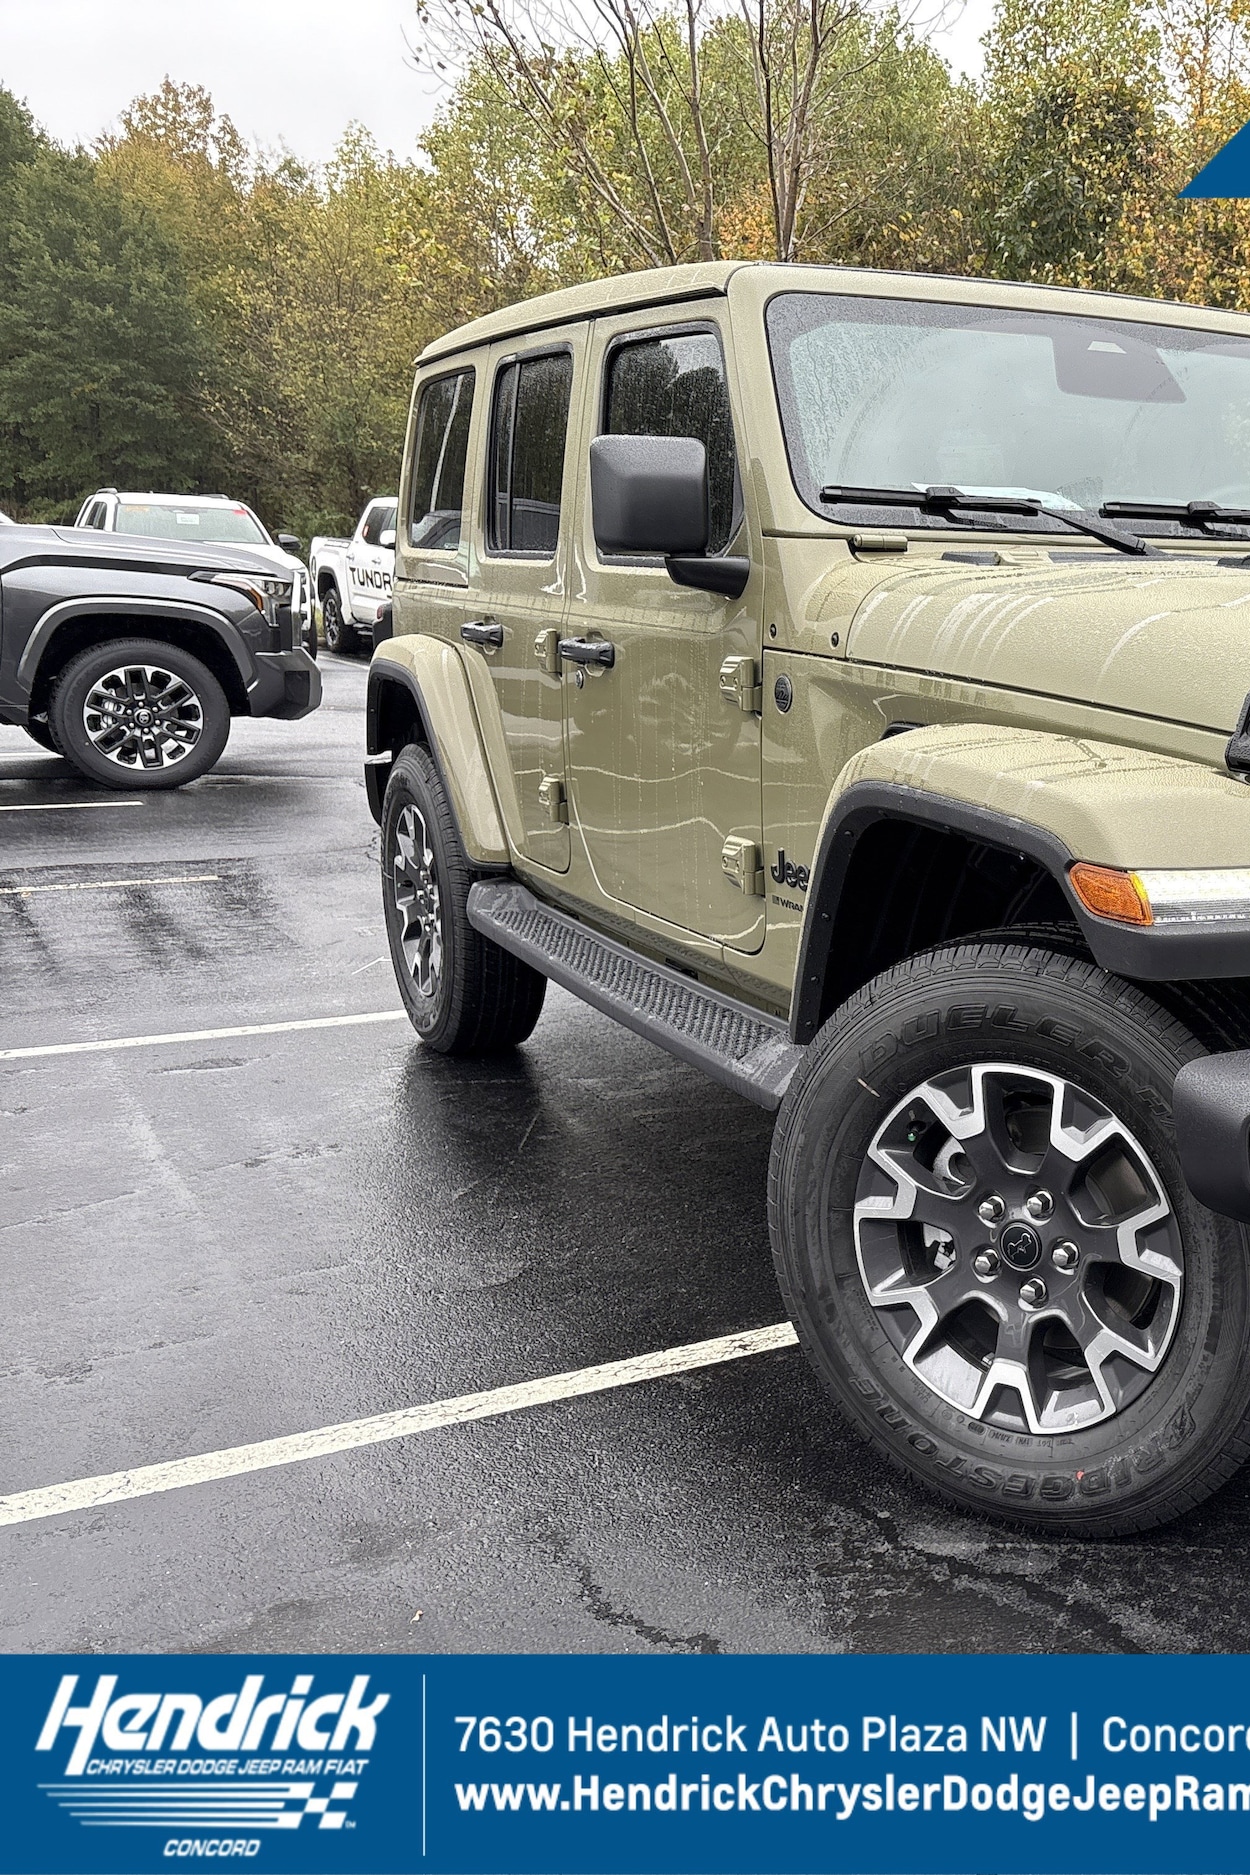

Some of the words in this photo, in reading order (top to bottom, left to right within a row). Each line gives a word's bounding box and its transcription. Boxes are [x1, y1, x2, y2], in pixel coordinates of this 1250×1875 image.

[349, 566, 393, 591] TUNDR
[770, 847, 811, 892] Jee
[857, 1003, 1132, 1080] DUELER
